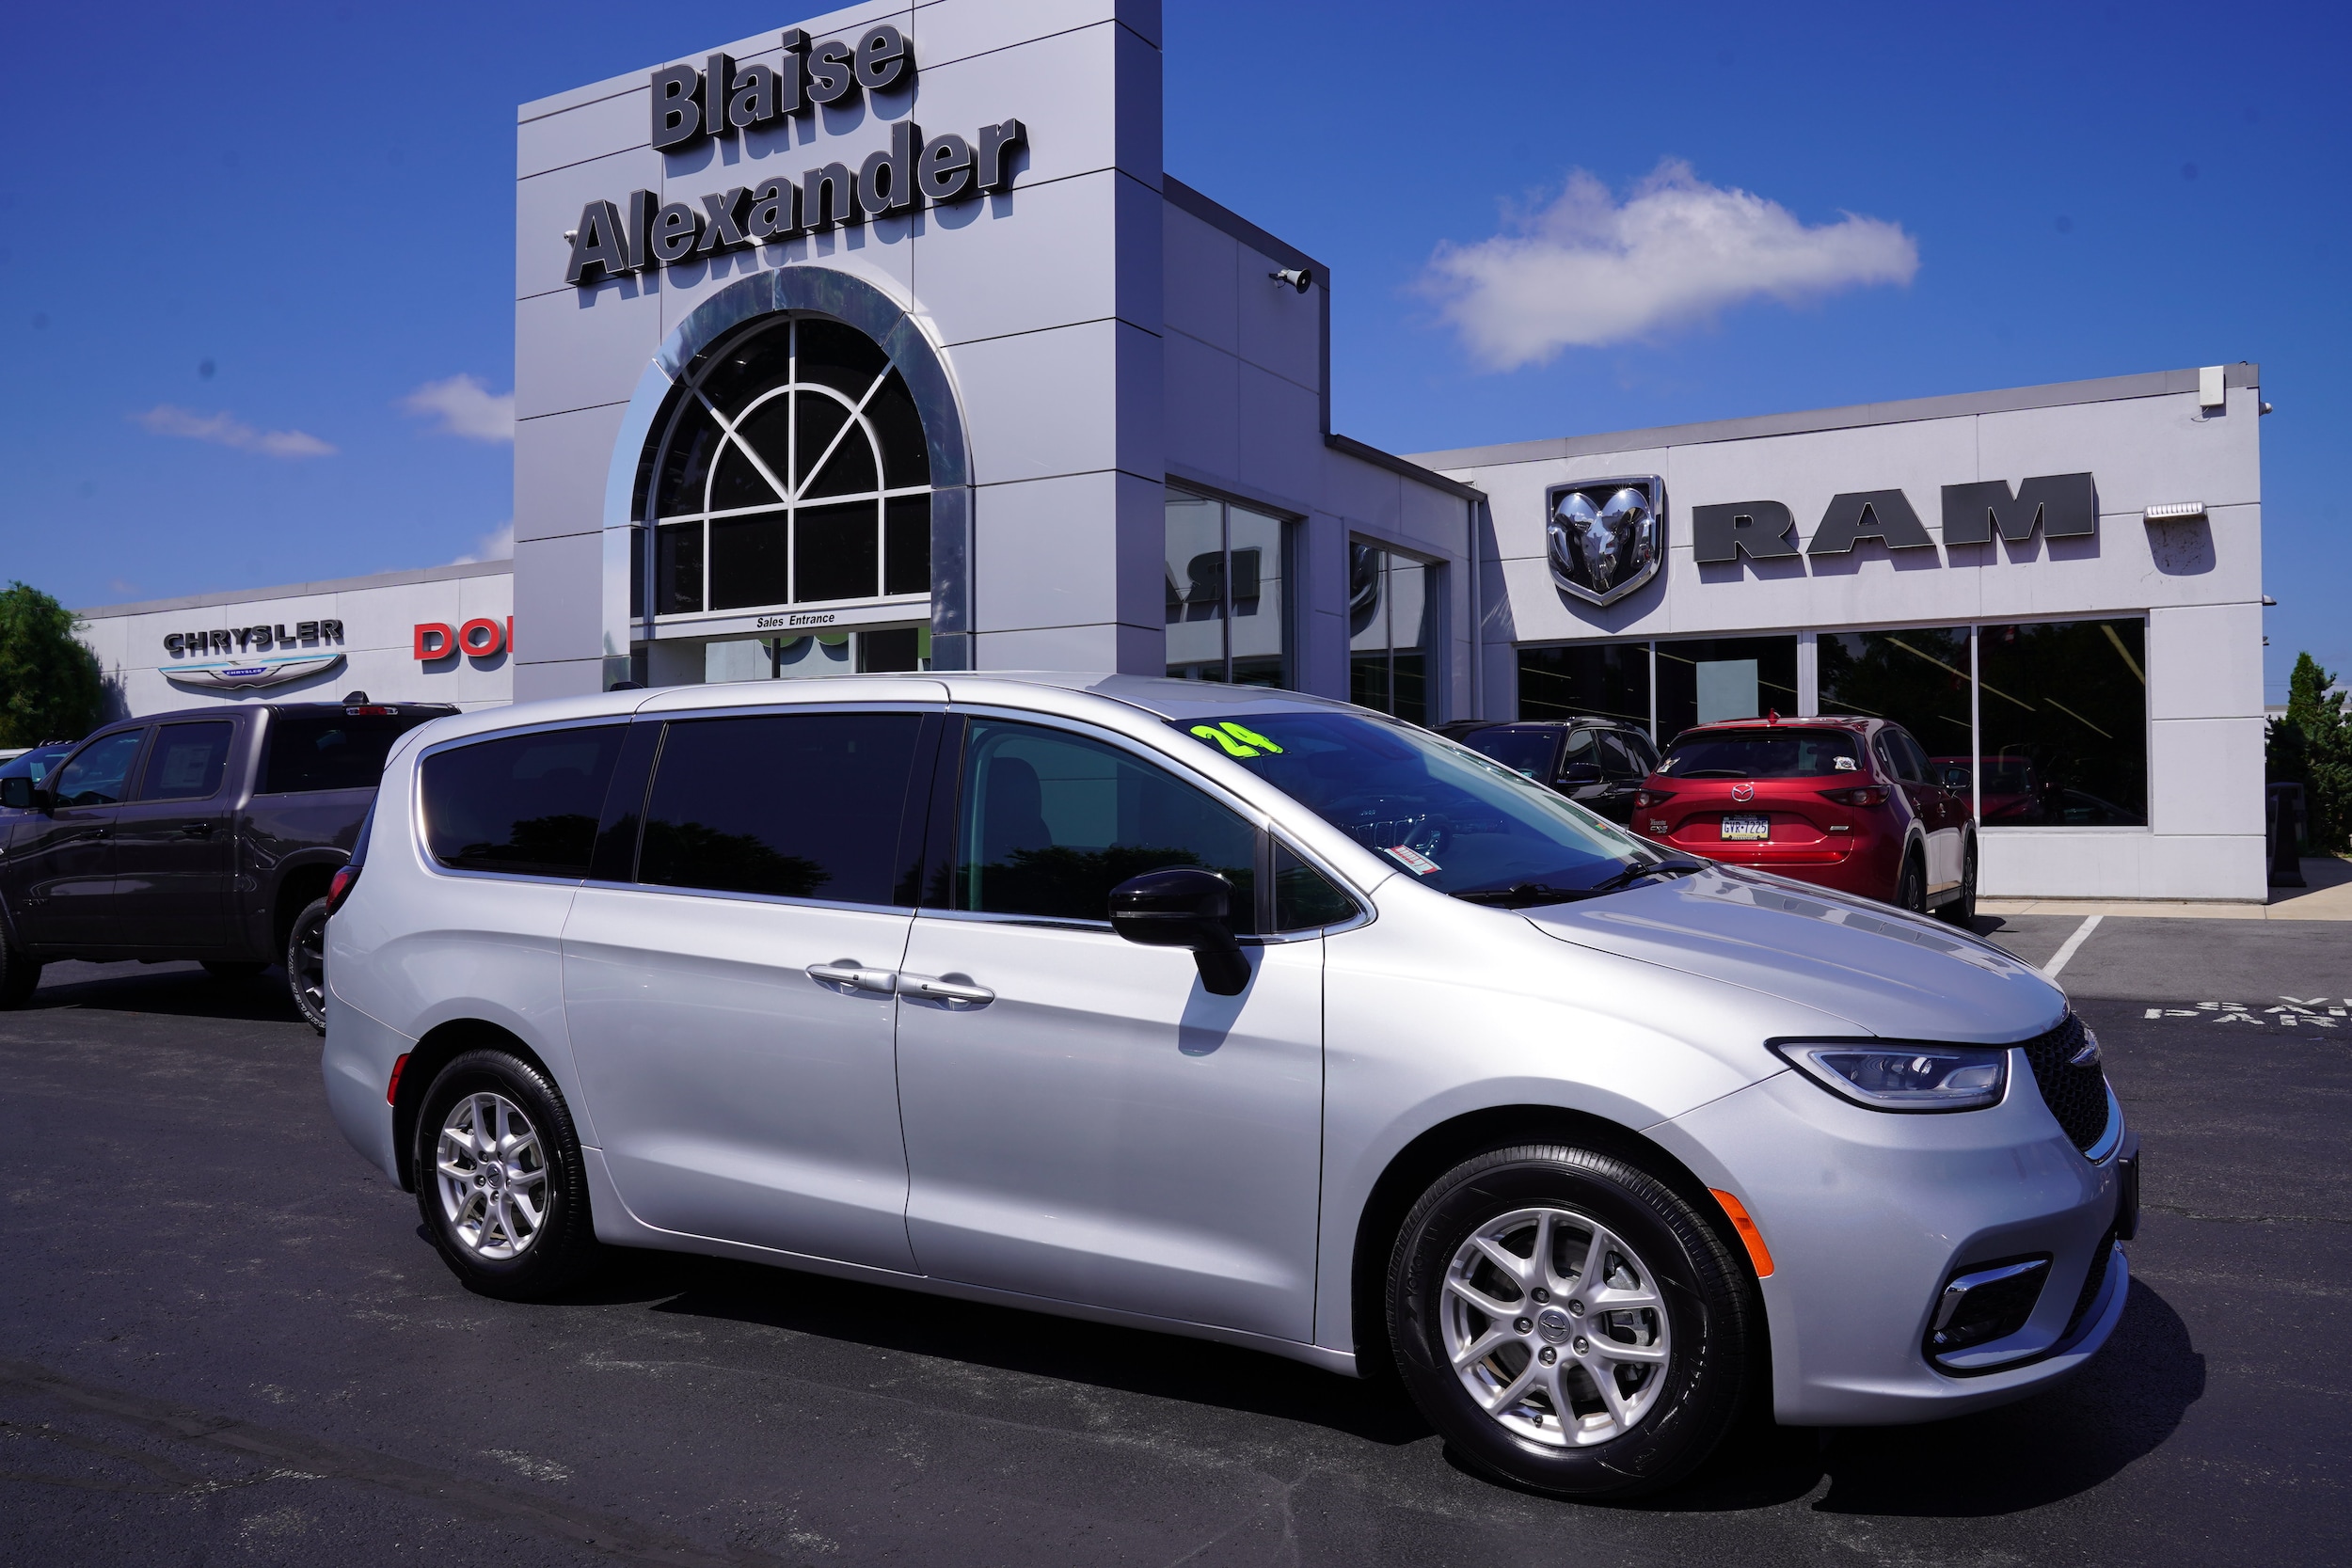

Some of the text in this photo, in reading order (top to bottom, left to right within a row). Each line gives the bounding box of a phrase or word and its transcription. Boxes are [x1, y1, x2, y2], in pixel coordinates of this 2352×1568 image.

[650, 24, 914, 152] Blaise
[565, 118, 1025, 286] Alexander
[1692, 472, 2095, 562] RAM
[164, 619, 342, 652] CHRYSLER
[756, 614, 835, 628] Sales Entrance
[1190, 721, 1283, 757] 24
